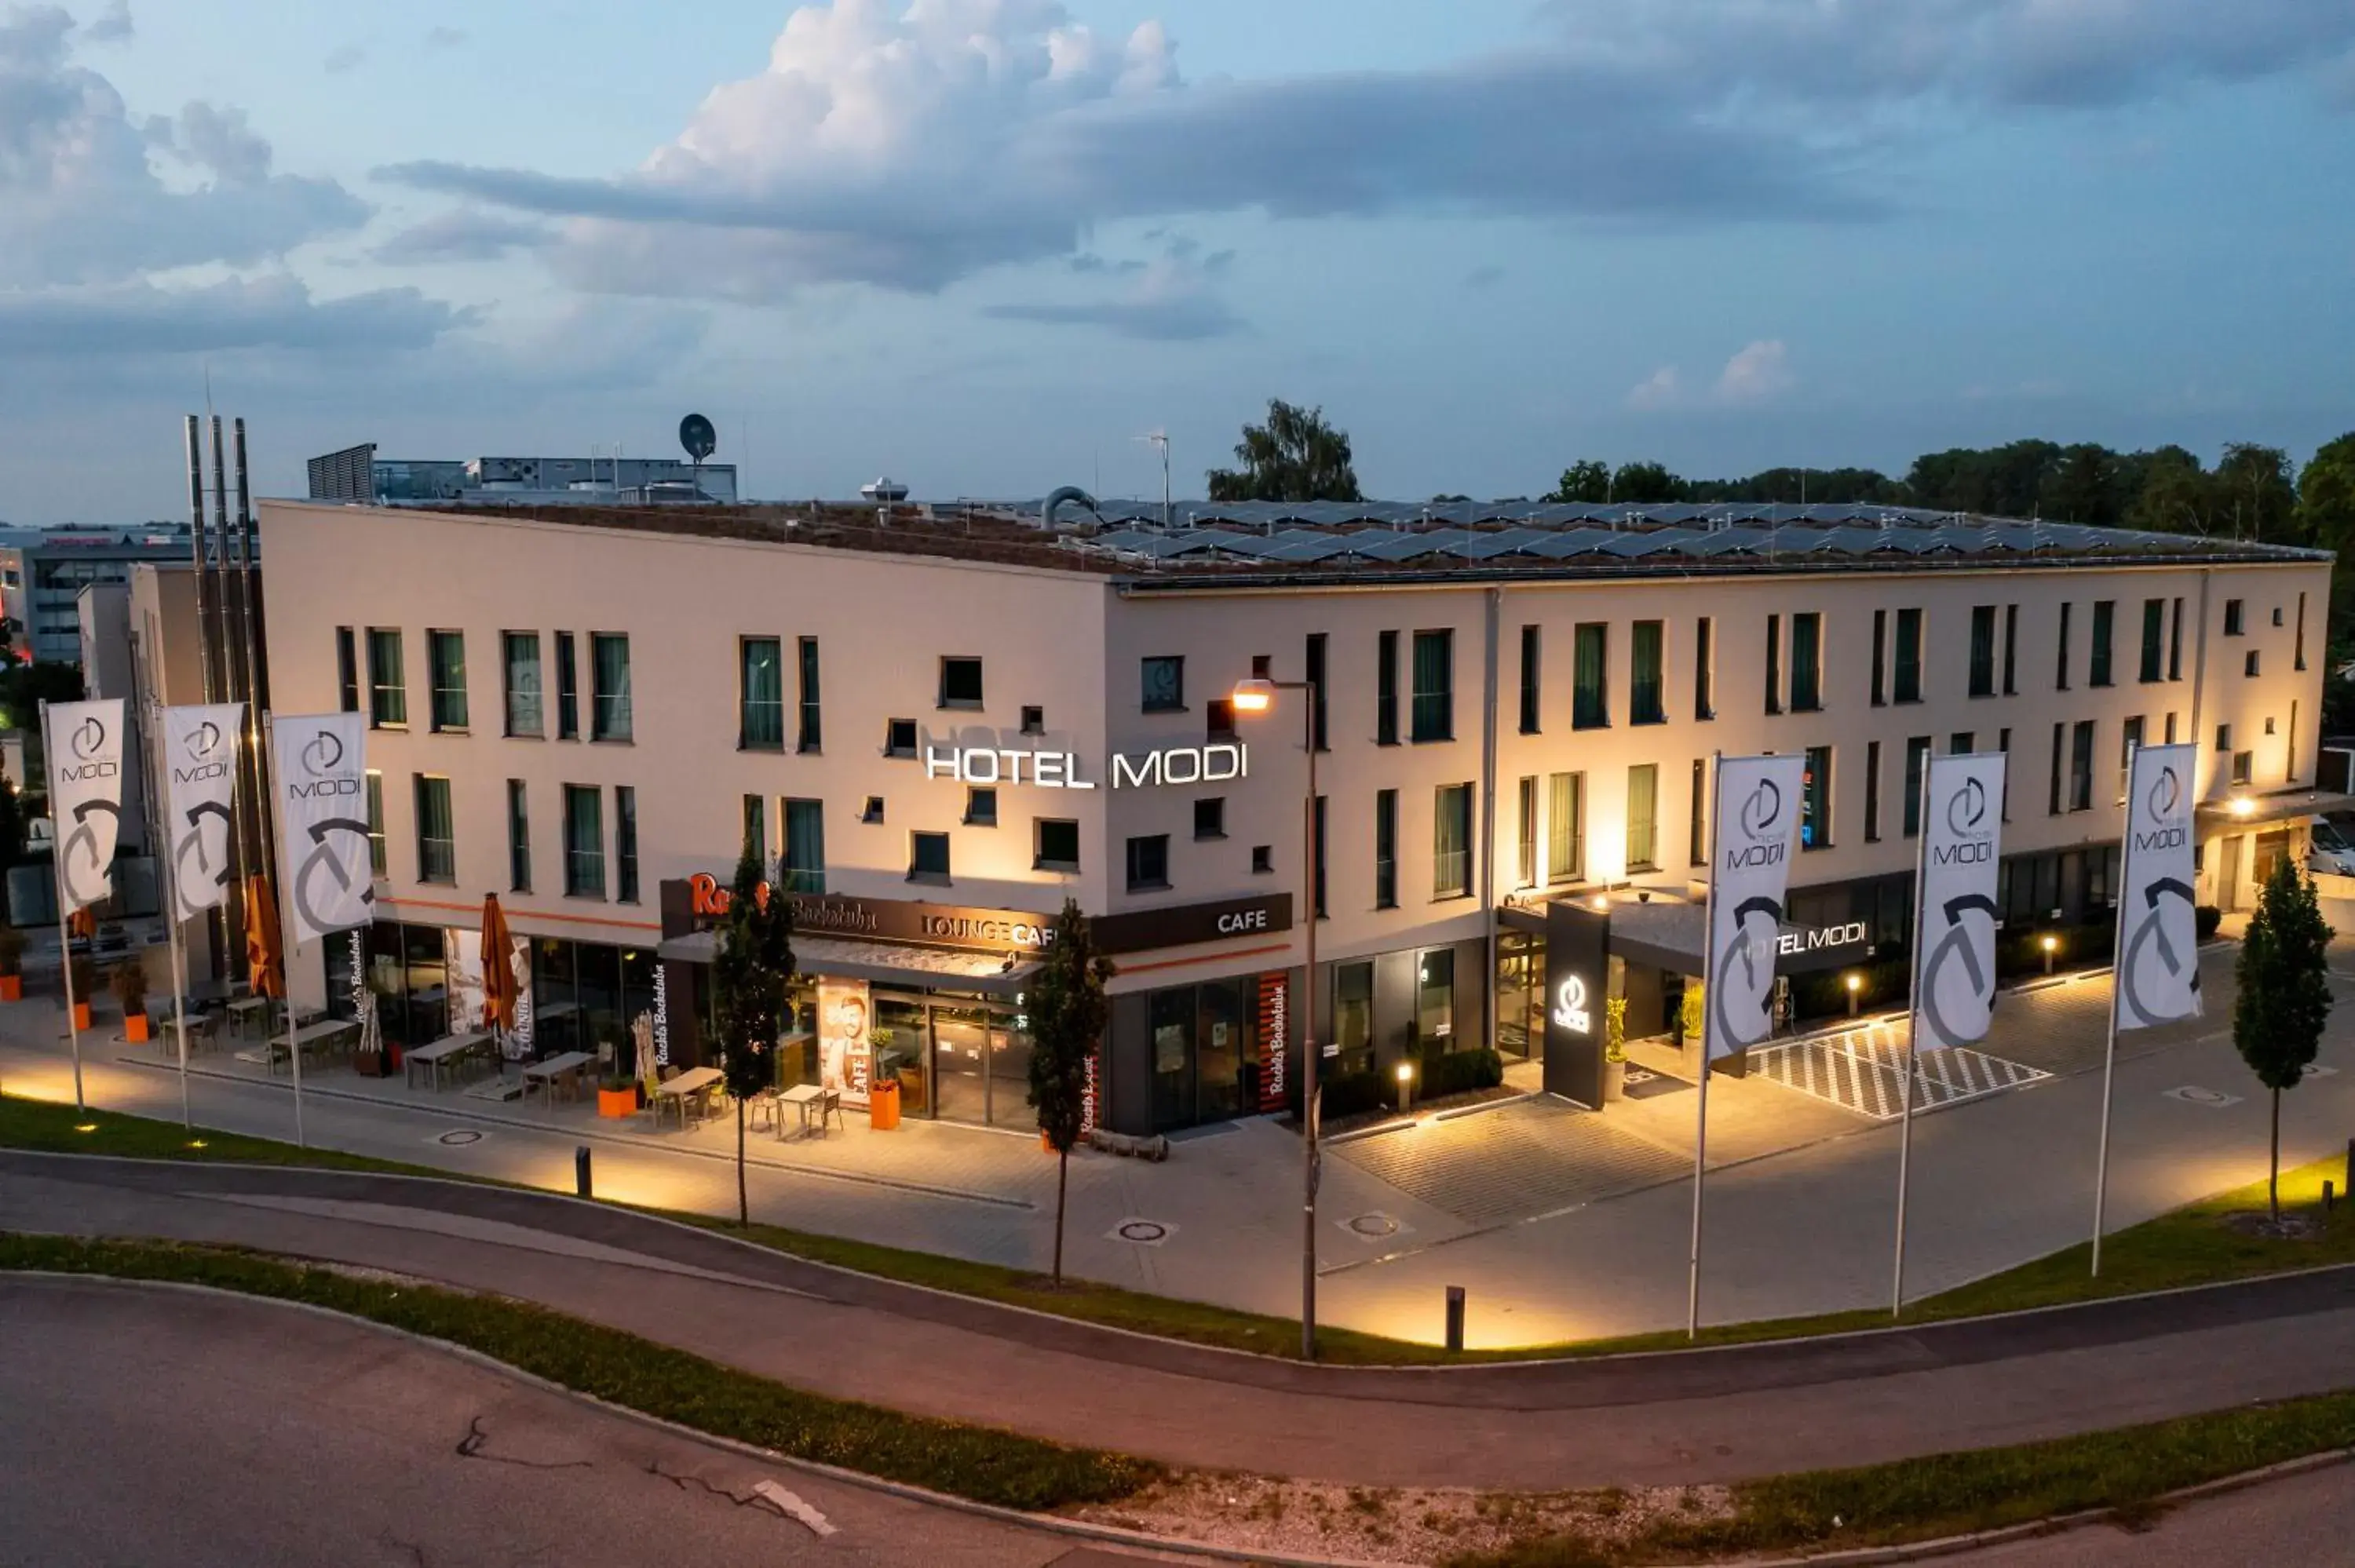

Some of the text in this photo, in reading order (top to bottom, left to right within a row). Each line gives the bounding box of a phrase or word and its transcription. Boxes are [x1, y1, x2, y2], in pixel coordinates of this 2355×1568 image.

[62, 762, 117, 782] MODI
[174, 762, 227, 783] MODI
[926, 743, 1248, 789] HOTEL MODI
[289, 779, 360, 799] MODI
[2134, 828, 2186, 851] MODI
[1726, 841, 1785, 871] MODI
[1933, 841, 1992, 866] MODI
[1218, 910, 1267, 934] CAFE
[1807, 921, 1866, 950] MODI
